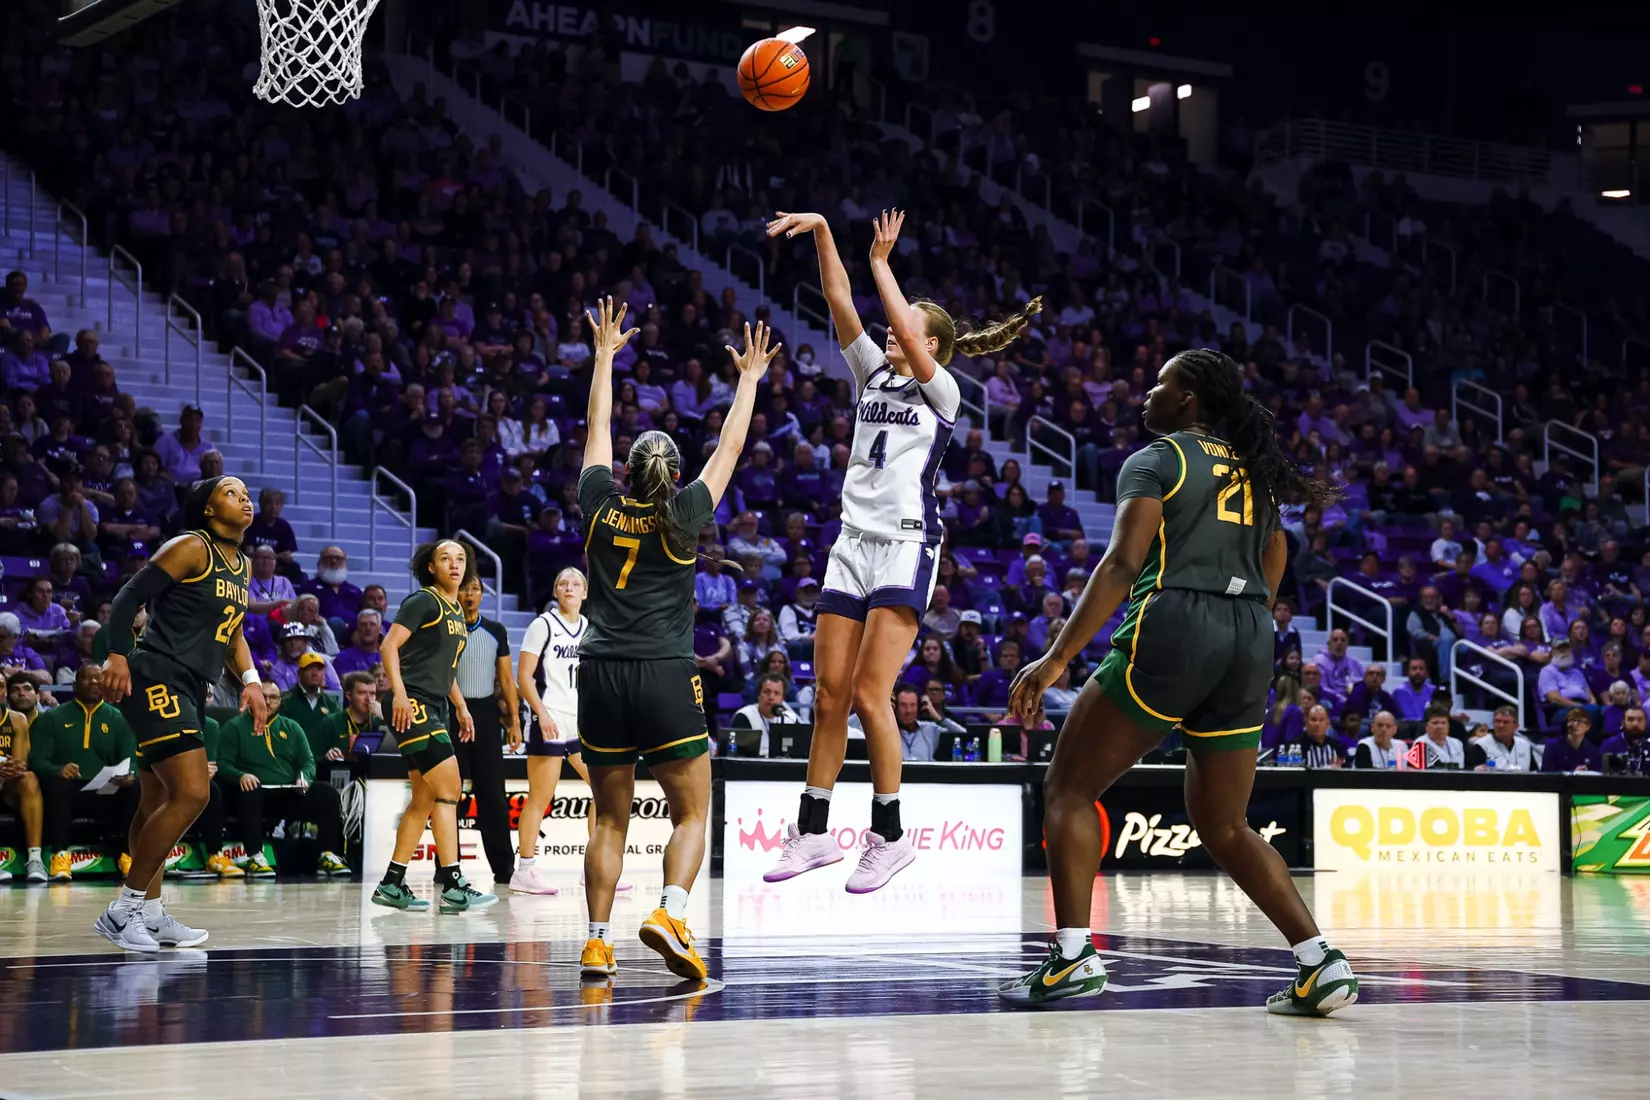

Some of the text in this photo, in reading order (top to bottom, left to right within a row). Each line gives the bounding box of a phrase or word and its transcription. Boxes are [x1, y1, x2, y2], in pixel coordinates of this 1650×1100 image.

[966, 0, 996, 44] 8
[1362, 58, 1390, 102] 9
[858, 400, 921, 426] Wildcats
[868, 430, 889, 470] 4
[1212, 463, 1254, 526] 21
[601, 507, 657, 535] JENNINGS
[613, 535, 641, 590] 7
[214, 604, 245, 645] 24
[145, 684, 182, 720] BU
[1329, 804, 1542, 862] QDOBA
[1378, 851, 1538, 863] MEXICAN EATS
